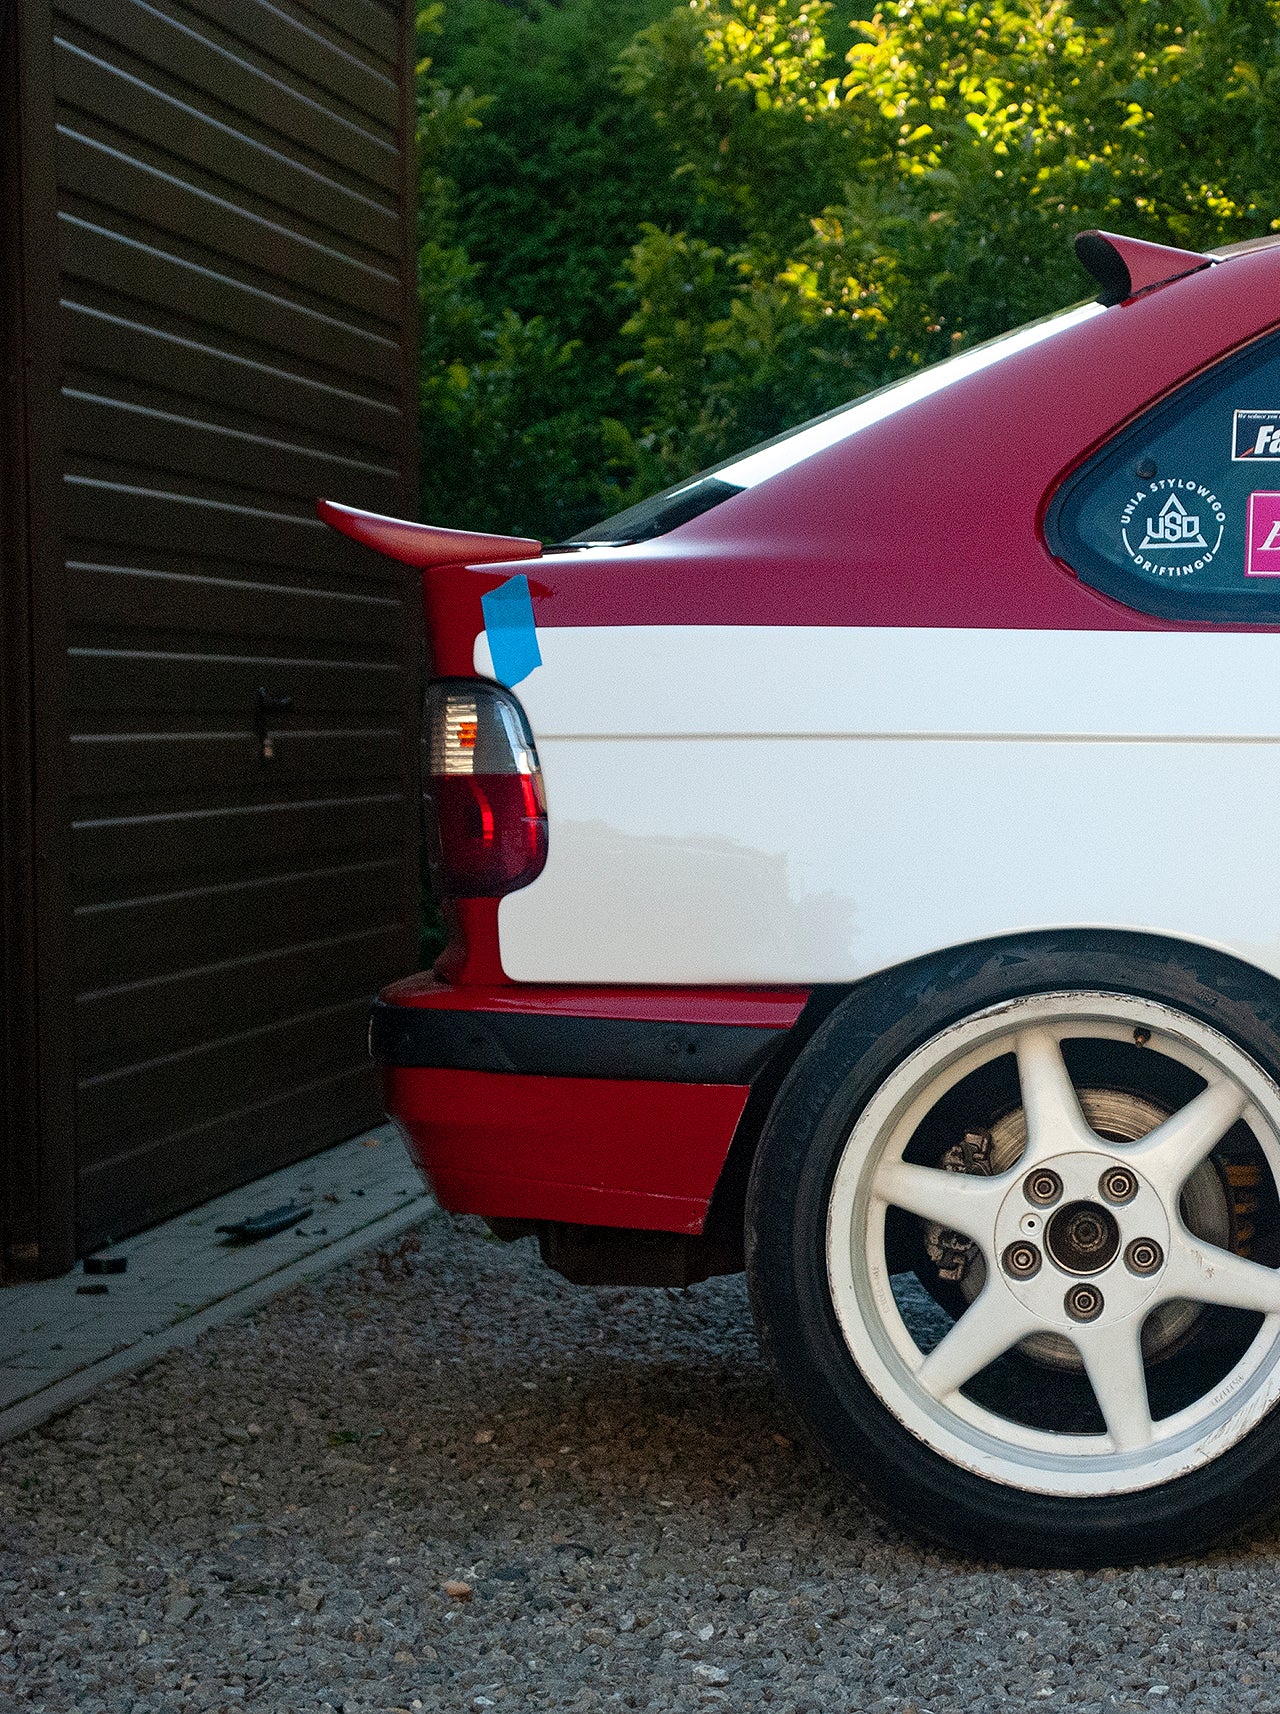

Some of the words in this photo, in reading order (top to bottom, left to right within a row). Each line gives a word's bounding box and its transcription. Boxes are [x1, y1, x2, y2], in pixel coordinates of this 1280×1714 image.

[1120, 491, 1147, 524] UNIA
[1149, 478, 1226, 522] STYLOWEGO
[1133, 552, 1213, 577] DRIFTINGU
